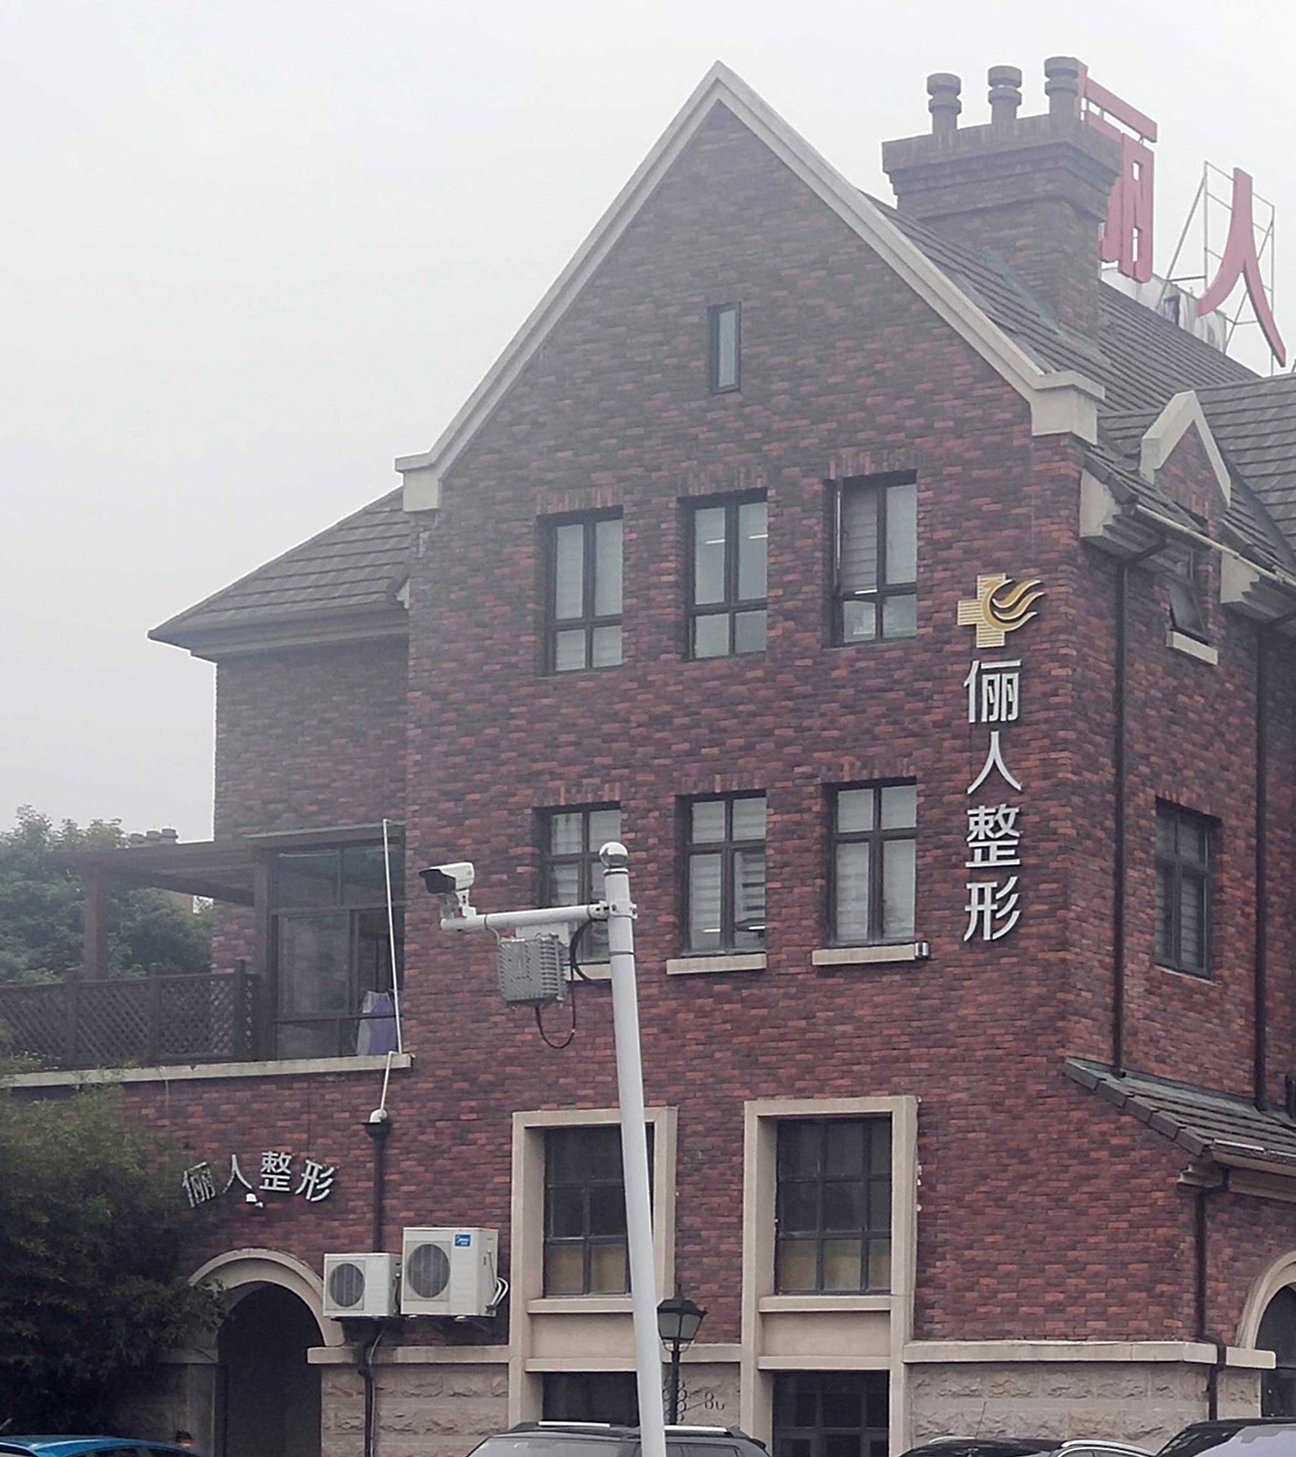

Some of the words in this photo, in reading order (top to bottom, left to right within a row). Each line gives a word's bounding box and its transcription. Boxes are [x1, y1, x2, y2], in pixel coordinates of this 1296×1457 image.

[963, 659, 1023, 942] 俪人整形
[182, 1150, 335, 1208] 俪人整形
